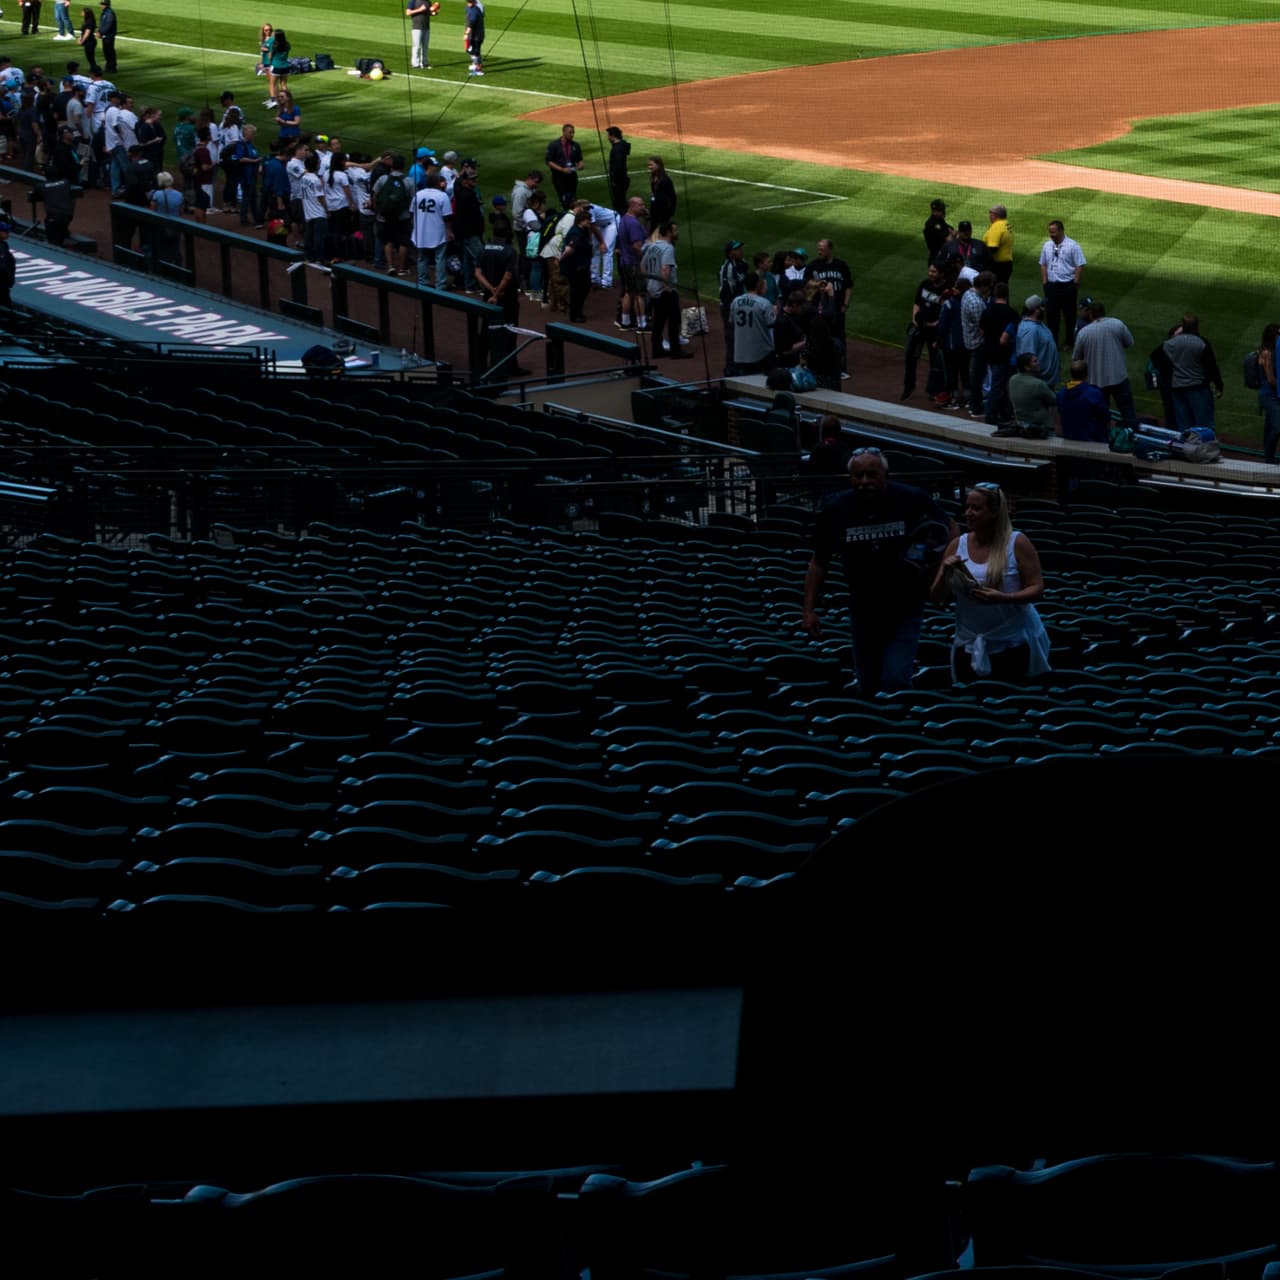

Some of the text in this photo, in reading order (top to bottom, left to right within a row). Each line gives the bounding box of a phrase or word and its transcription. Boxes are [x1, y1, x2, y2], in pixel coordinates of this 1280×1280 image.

[418, 198, 436, 213] 42
[36, 271, 176, 322] T-MOBILE
[143, 304, 290, 350] PARK
[735, 310, 754, 327] 31
